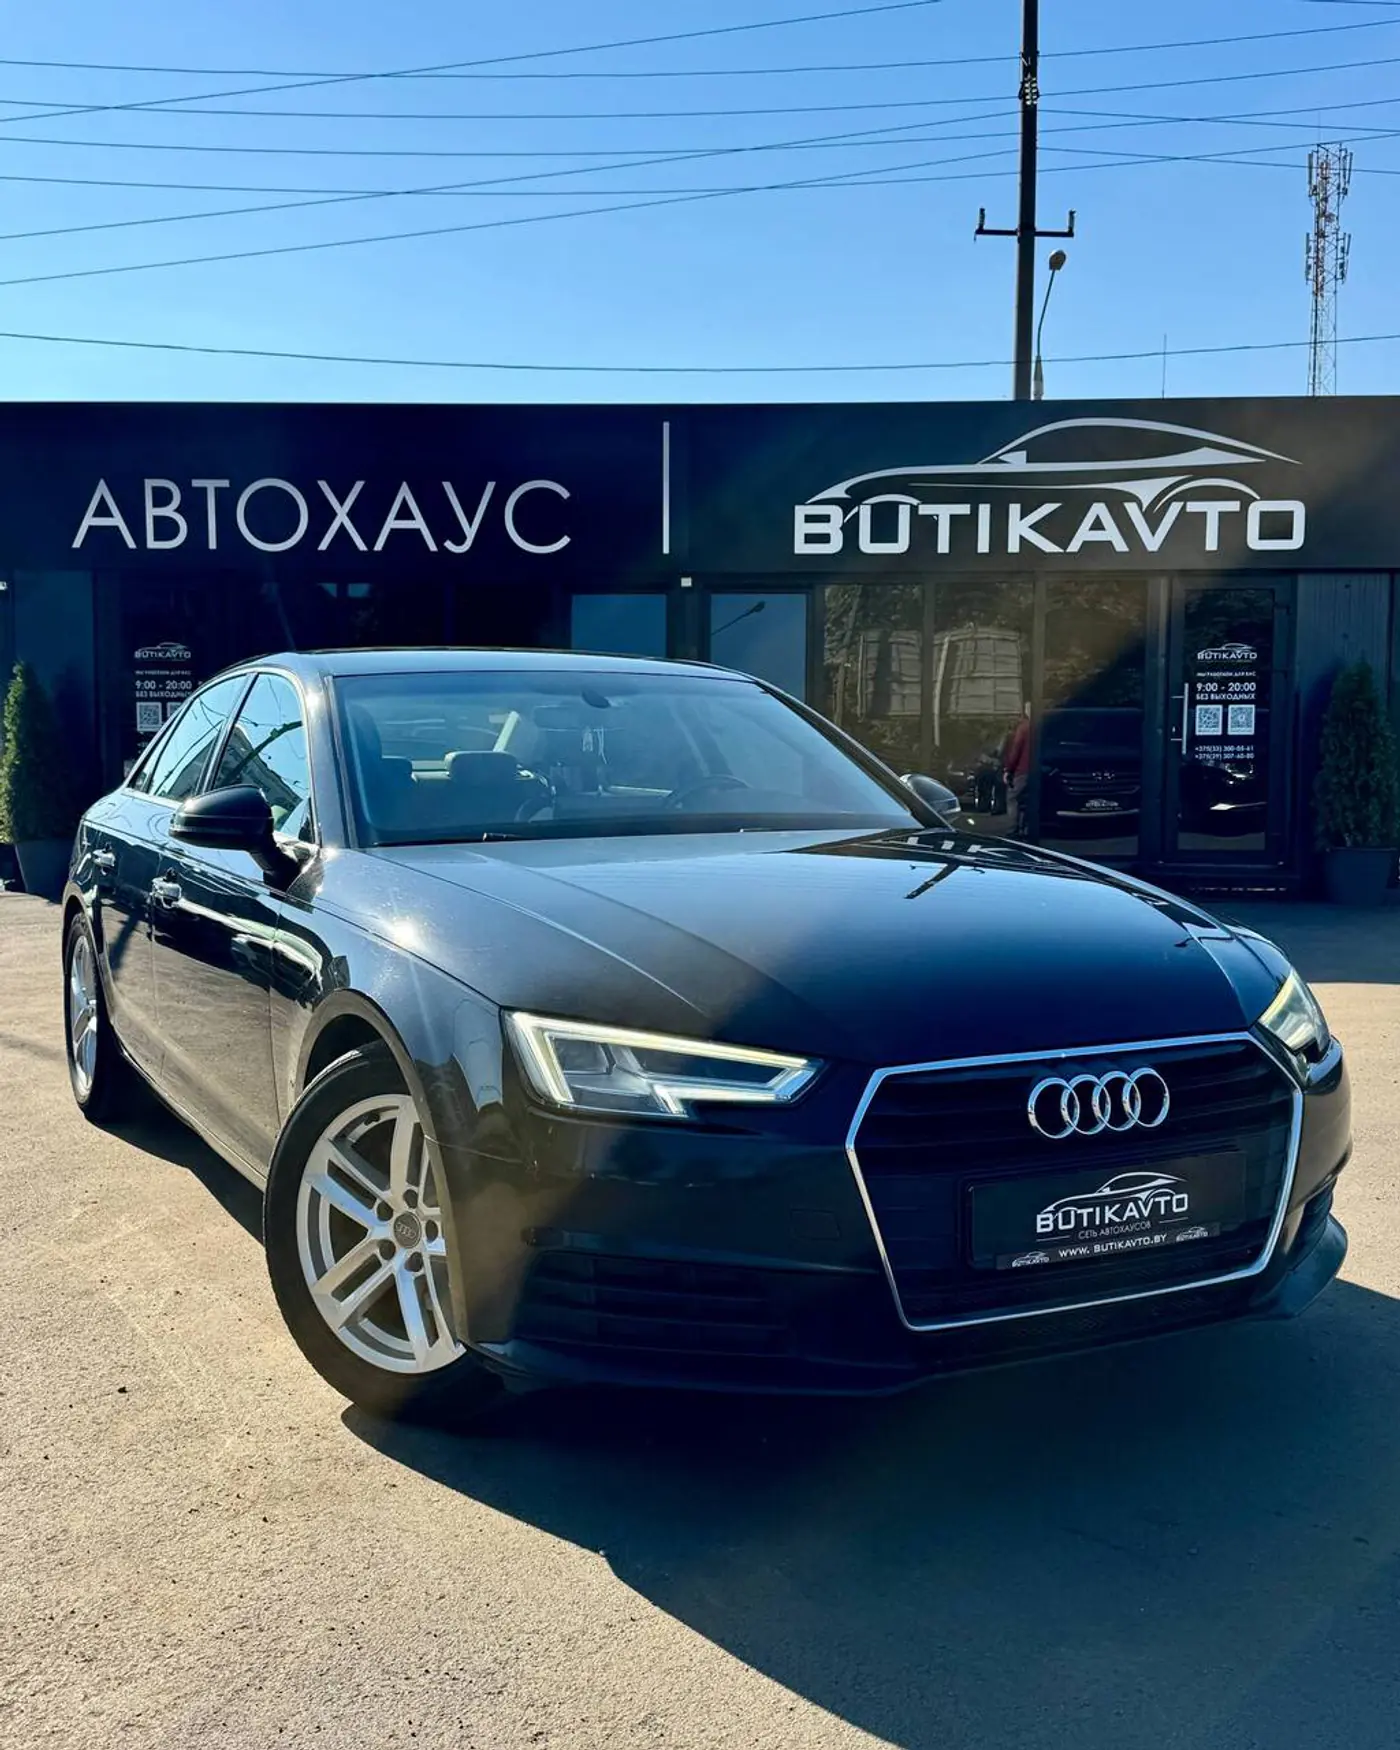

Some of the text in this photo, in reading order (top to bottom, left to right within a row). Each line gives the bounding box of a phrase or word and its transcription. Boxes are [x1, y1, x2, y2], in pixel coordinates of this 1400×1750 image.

[72, 478, 571, 554] АВТОХАУС
[793, 499, 1306, 556] BUTIKAVTO
[134, 650, 192, 659] BUTIKAVTO
[1197, 651, 1257, 660] BUTIKAVTO
[135, 680, 156, 690] 9:00
[165, 680, 192, 690] 20:00
[1196, 682, 1218, 692] 9:00
[1227, 682, 1257, 692] 20:00
[135, 690, 148, 698] БЕЗ
[1195, 693, 1256, 701] БЕЗ ВЫХОДНЫХ
[1036, 1193, 1189, 1233] BUTIKAVTO
[1078, 1220, 1152, 1240] СЕТЬ АВТОХАУСОВ
[1093, 1233, 1168, 1253] BUTIKAVTO.BY
